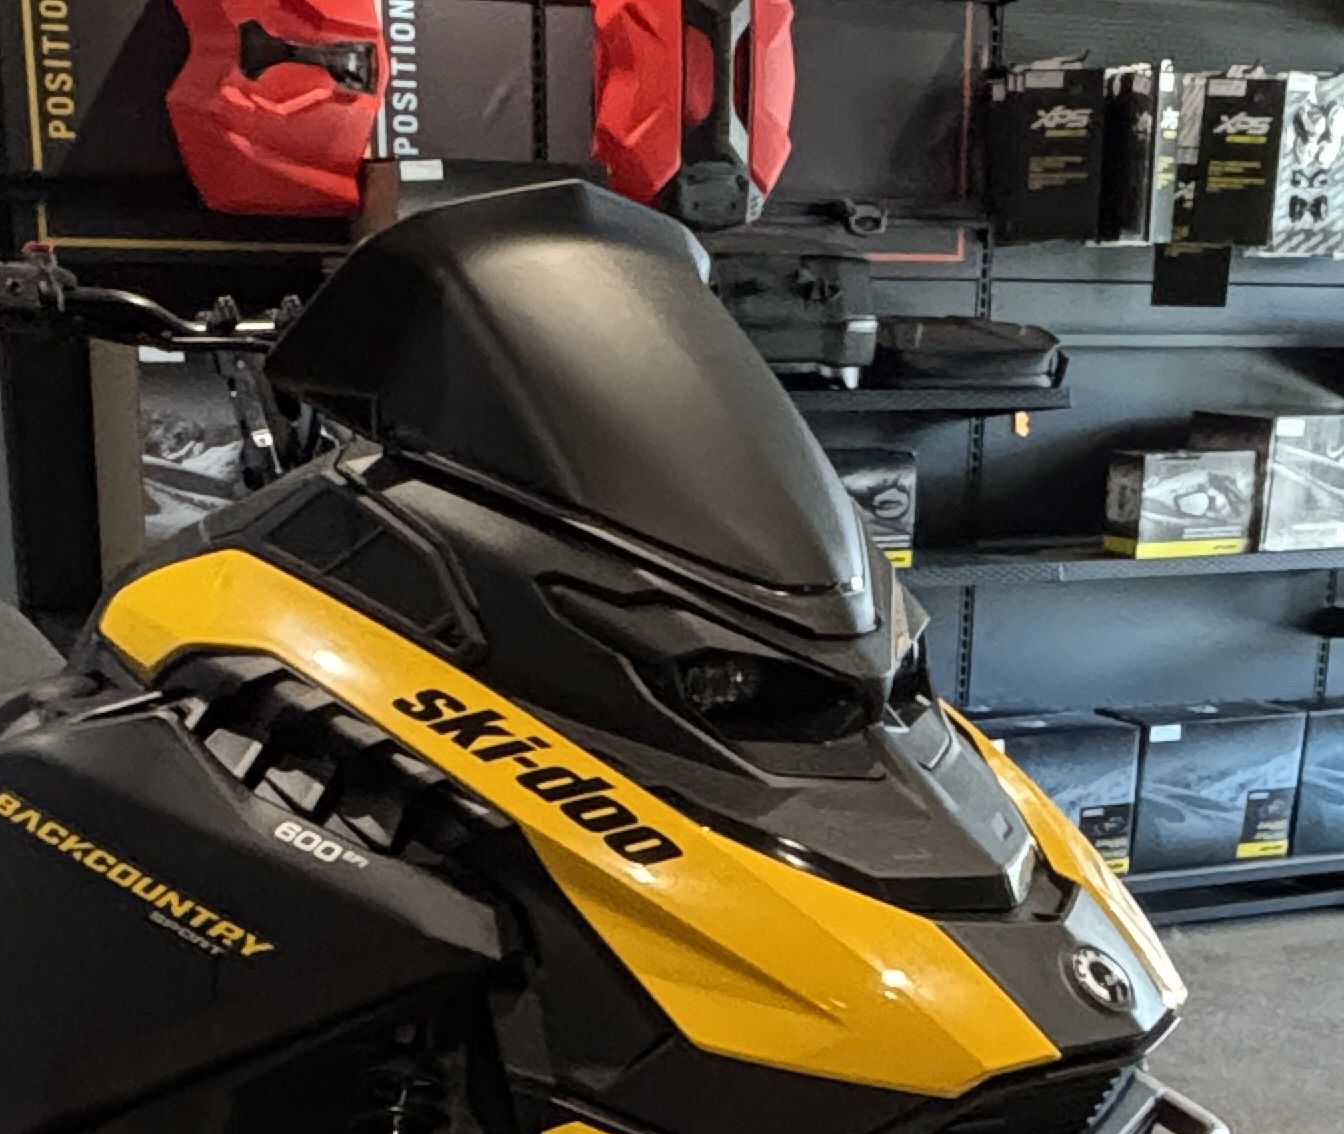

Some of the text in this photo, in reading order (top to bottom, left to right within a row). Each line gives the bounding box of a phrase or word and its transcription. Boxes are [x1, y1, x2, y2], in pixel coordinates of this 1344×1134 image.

[388, 0, 420, 156] POSITION
[1030, 104, 1093, 130] XPS
[1212, 111, 1273, 135] XPS
[392, 688, 684, 865] ski-doo
[274, 820, 344, 863] 600
